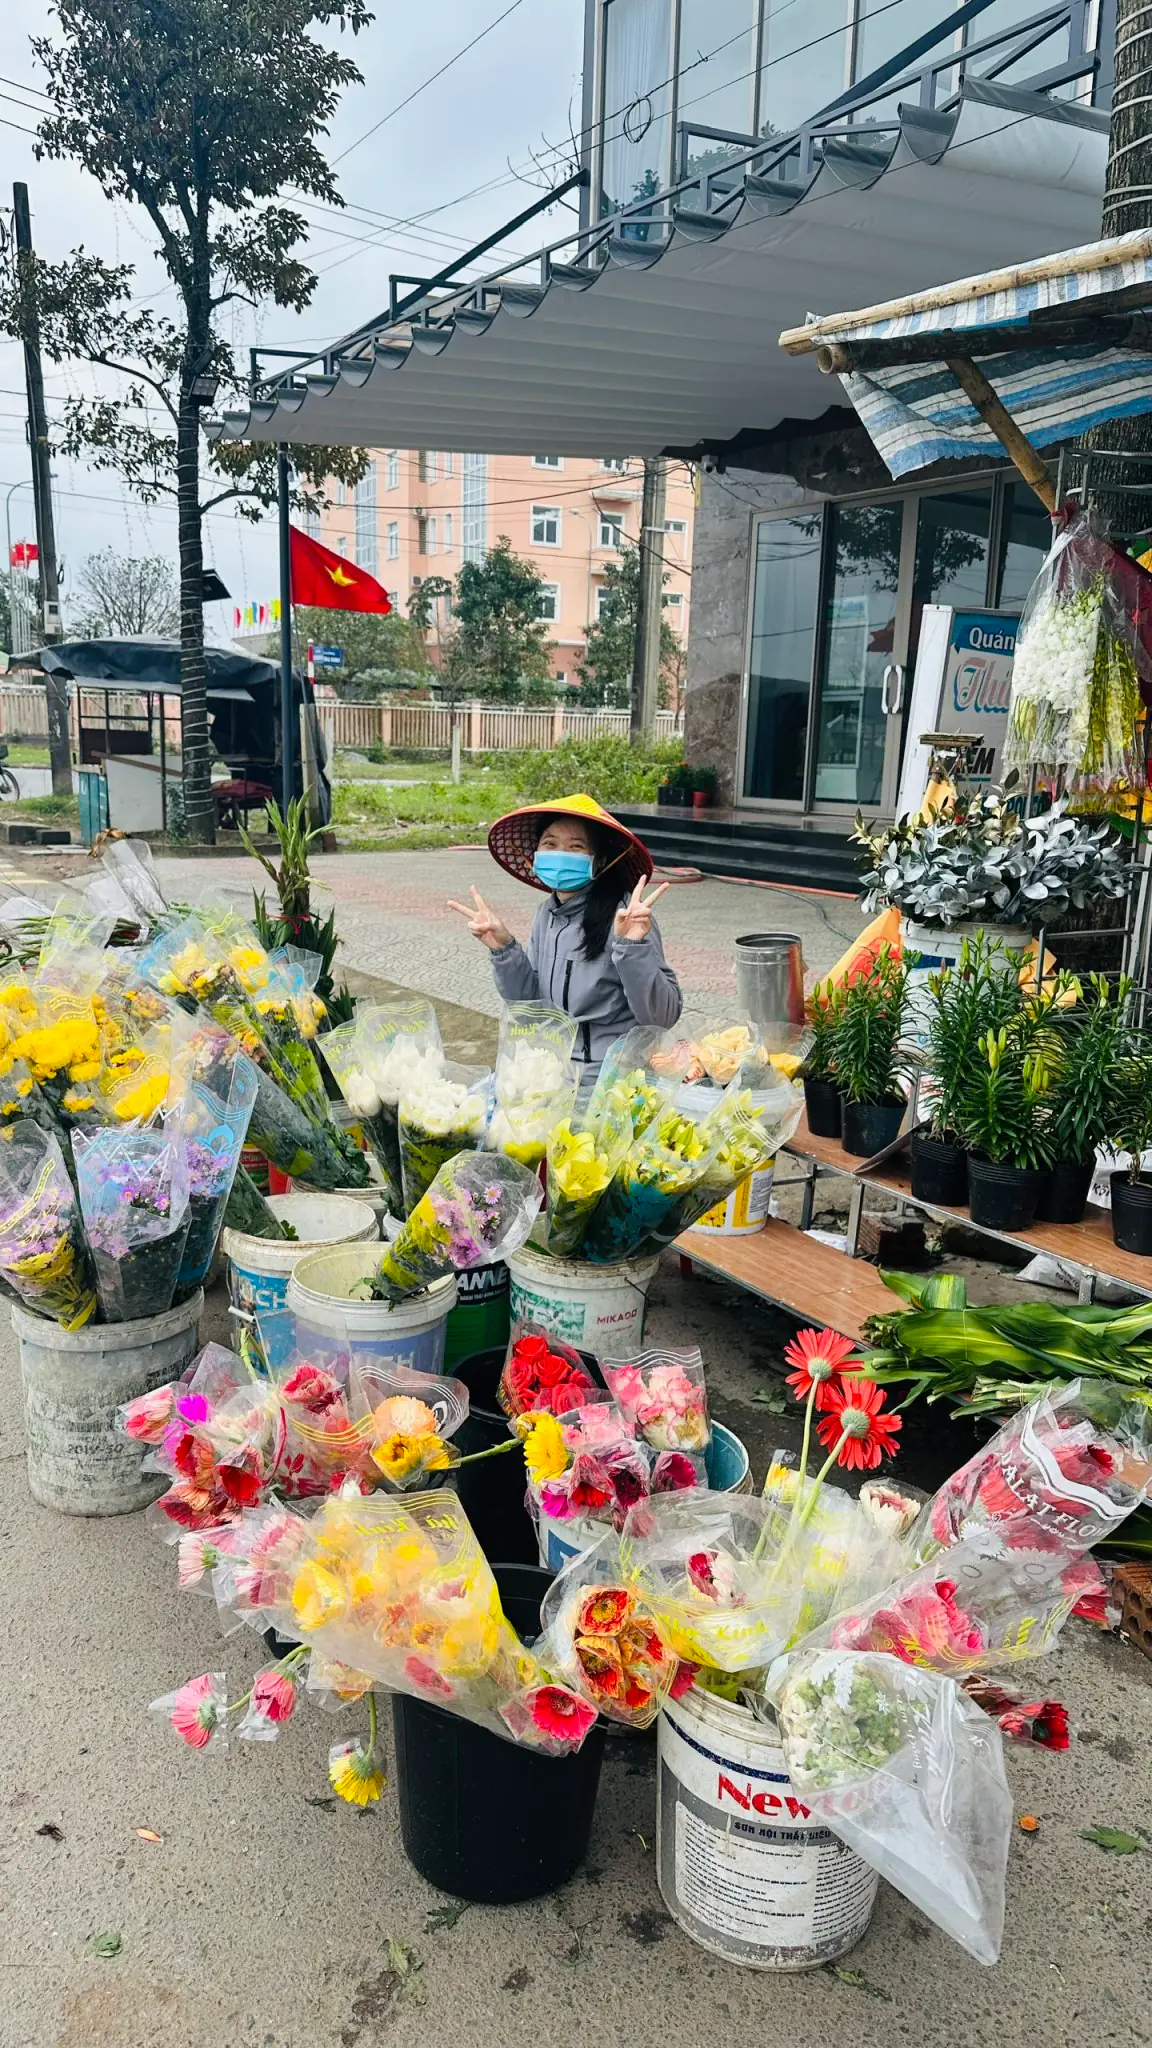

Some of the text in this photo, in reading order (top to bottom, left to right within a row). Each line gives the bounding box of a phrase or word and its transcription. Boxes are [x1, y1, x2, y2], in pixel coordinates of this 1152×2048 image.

[969, 627, 1016, 650] Quán
[953, 657, 1013, 713] Thú
[596, 1308, 639, 1325] MIKADO
